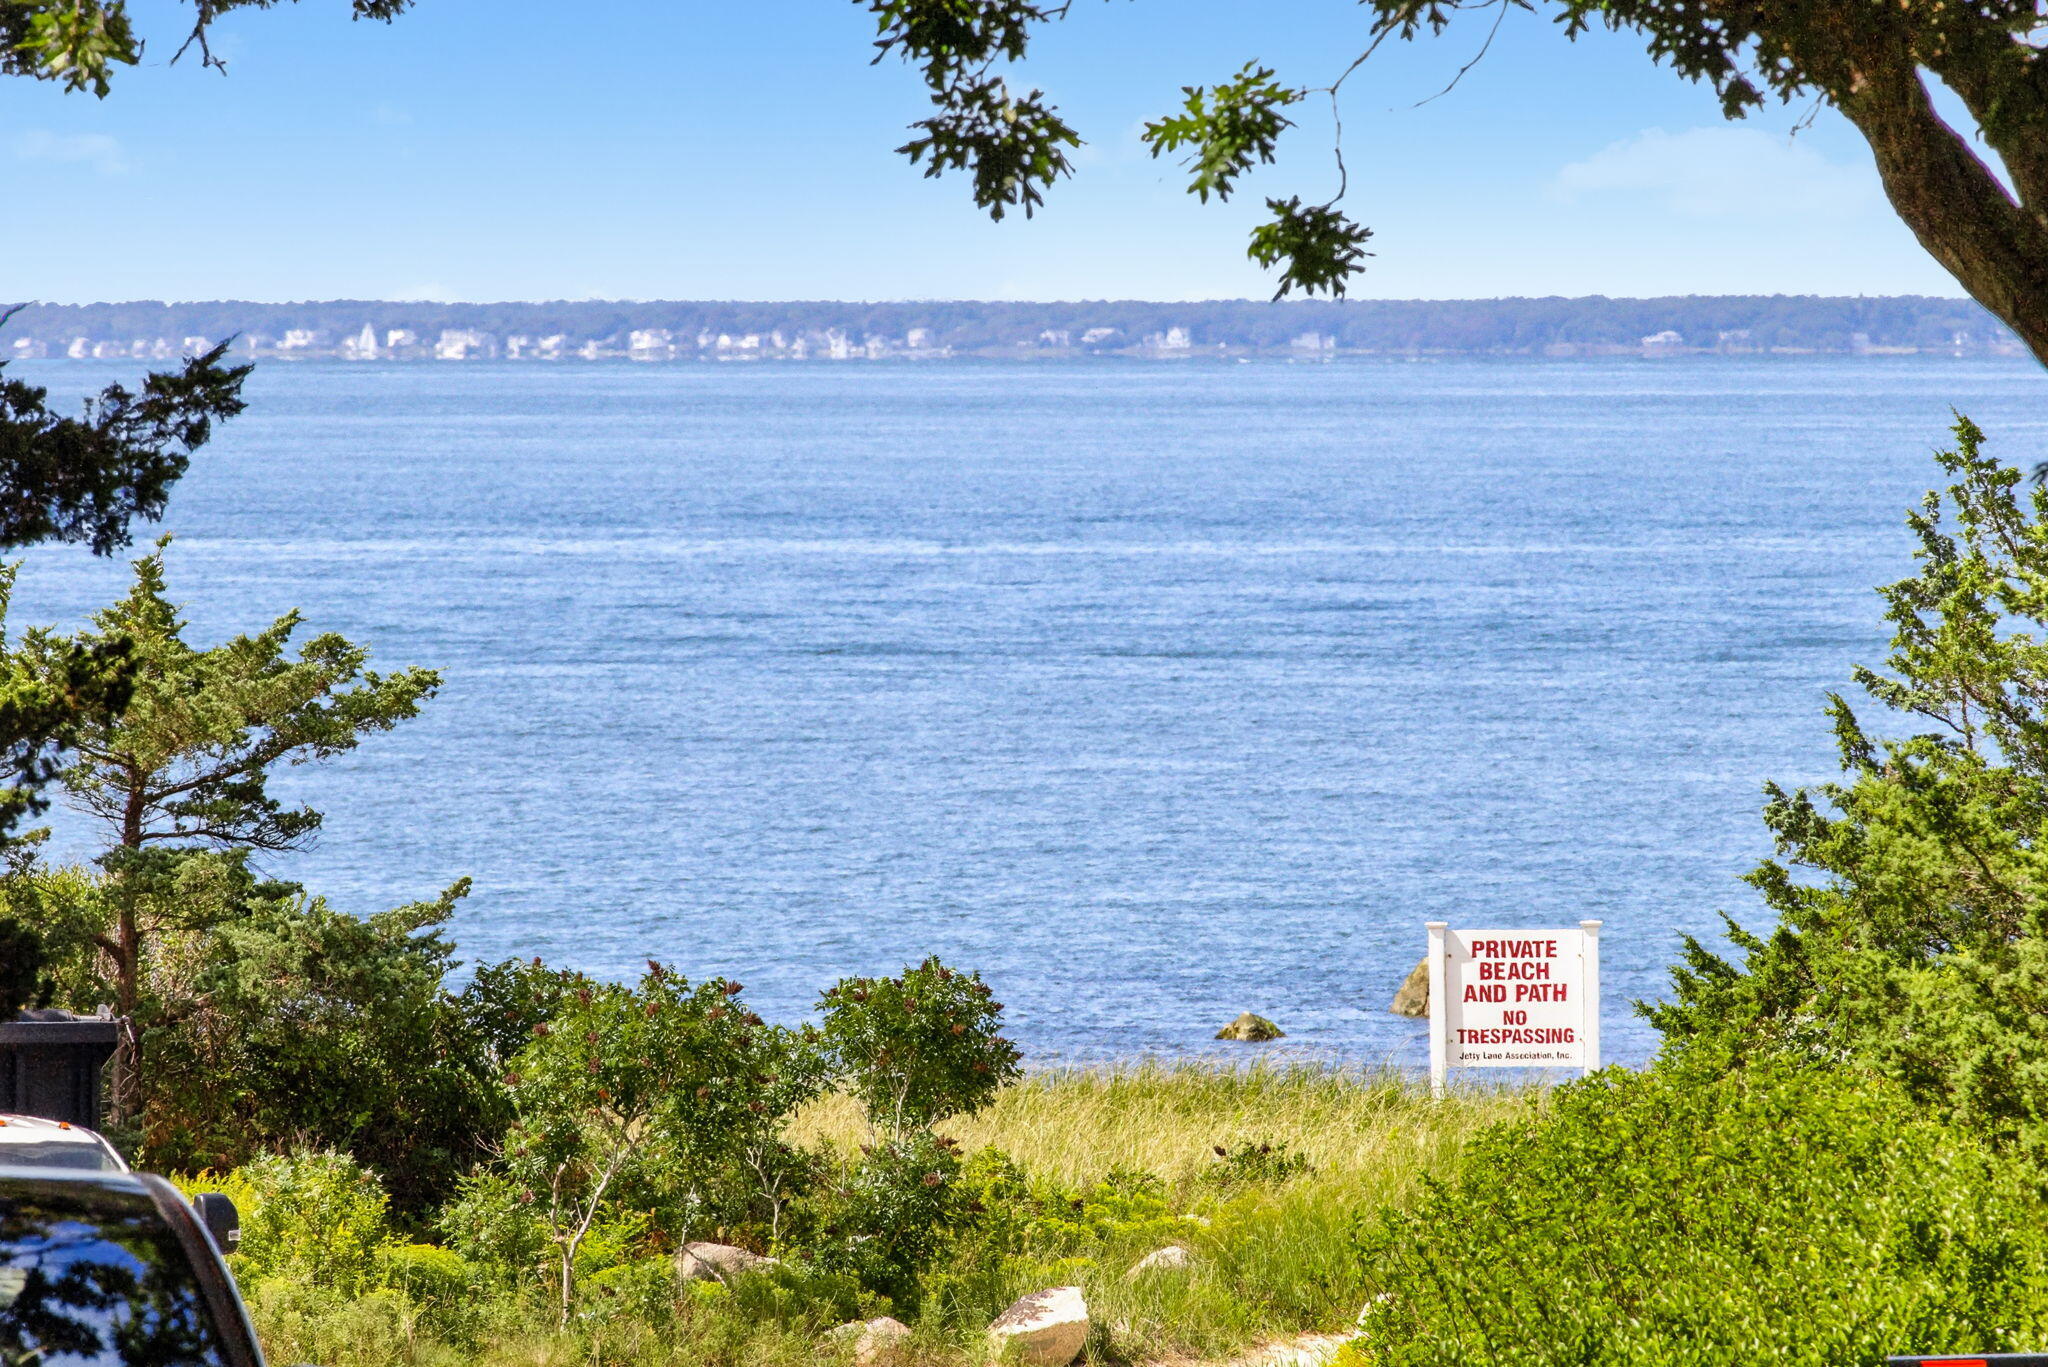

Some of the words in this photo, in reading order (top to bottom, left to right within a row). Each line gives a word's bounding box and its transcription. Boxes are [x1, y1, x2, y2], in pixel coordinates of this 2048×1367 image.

[1471, 940, 1557, 958] PRIVATE
[1479, 962, 1550, 980] BEACH
[1463, 984, 1507, 1002] AND
[1515, 984, 1567, 1002] PATH
[1503, 1010, 1527, 1025] NO
[1457, 1028, 1574, 1044] TRESPASSING
[1459, 1052, 1481, 1061] Jetty
[1483, 1052, 1502, 1060] Lane
[1557, 1052, 1573, 1060] Inc.
